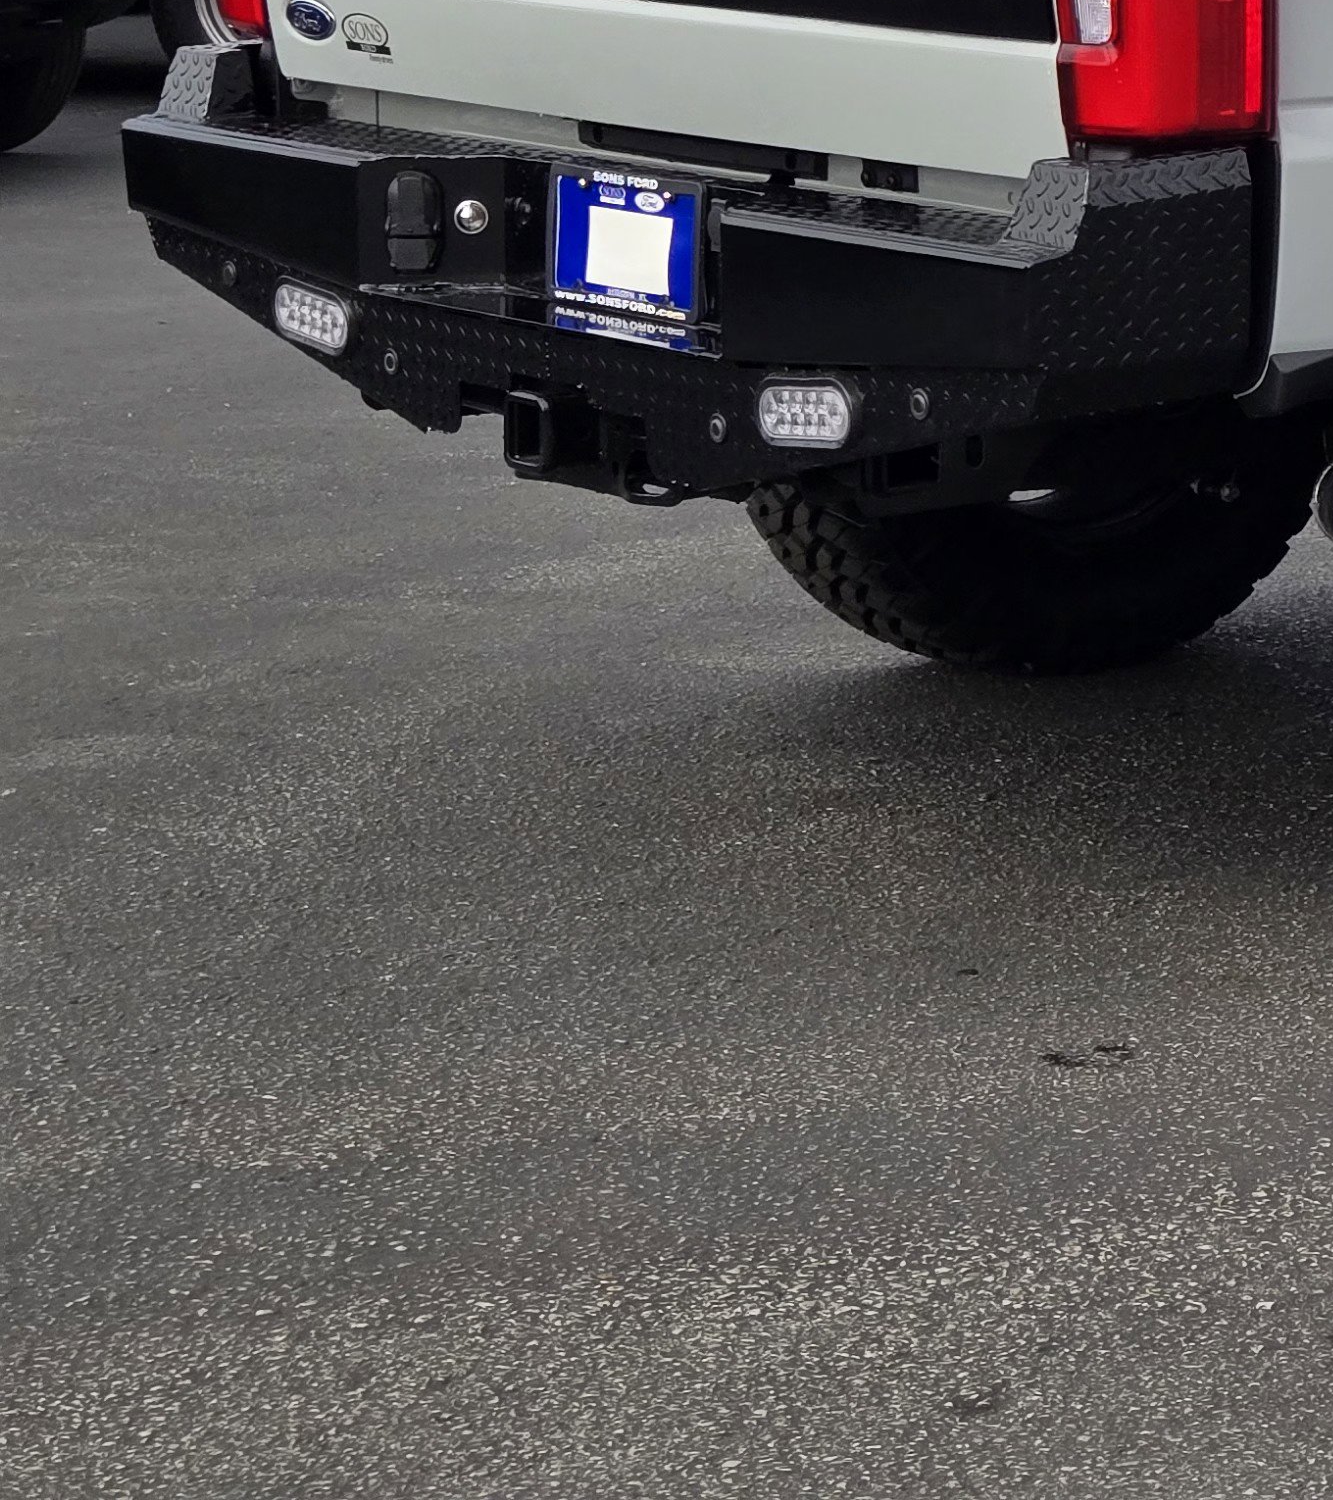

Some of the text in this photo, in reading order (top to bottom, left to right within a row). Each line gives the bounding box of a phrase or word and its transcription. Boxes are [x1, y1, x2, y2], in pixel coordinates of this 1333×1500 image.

[348, 20, 383, 43] SONS
[592, 170, 659, 191] SONS FORD
